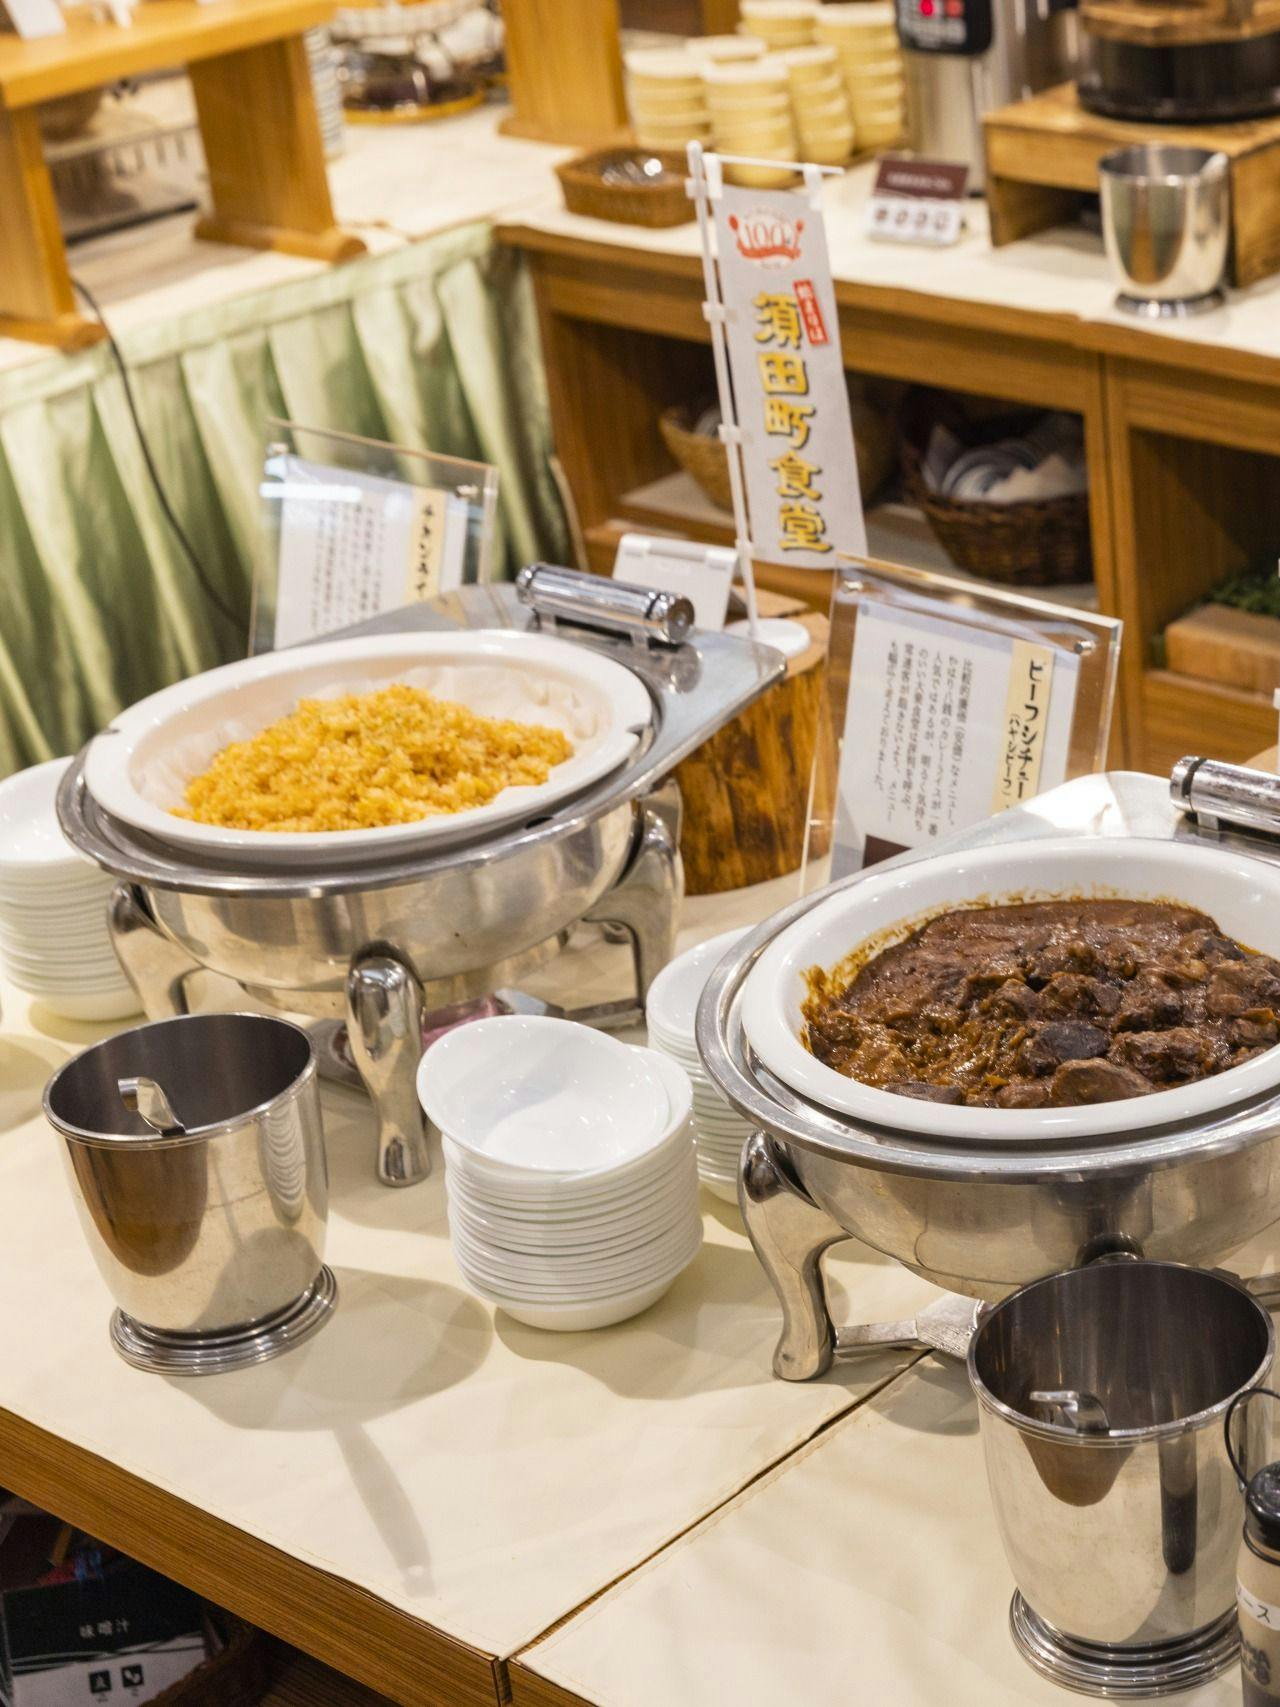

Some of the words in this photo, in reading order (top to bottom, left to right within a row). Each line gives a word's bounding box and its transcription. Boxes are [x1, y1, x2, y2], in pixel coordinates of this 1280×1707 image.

[753, 291, 832, 553] 須田町食堂
[1237, 1587, 1271, 1624] ース
